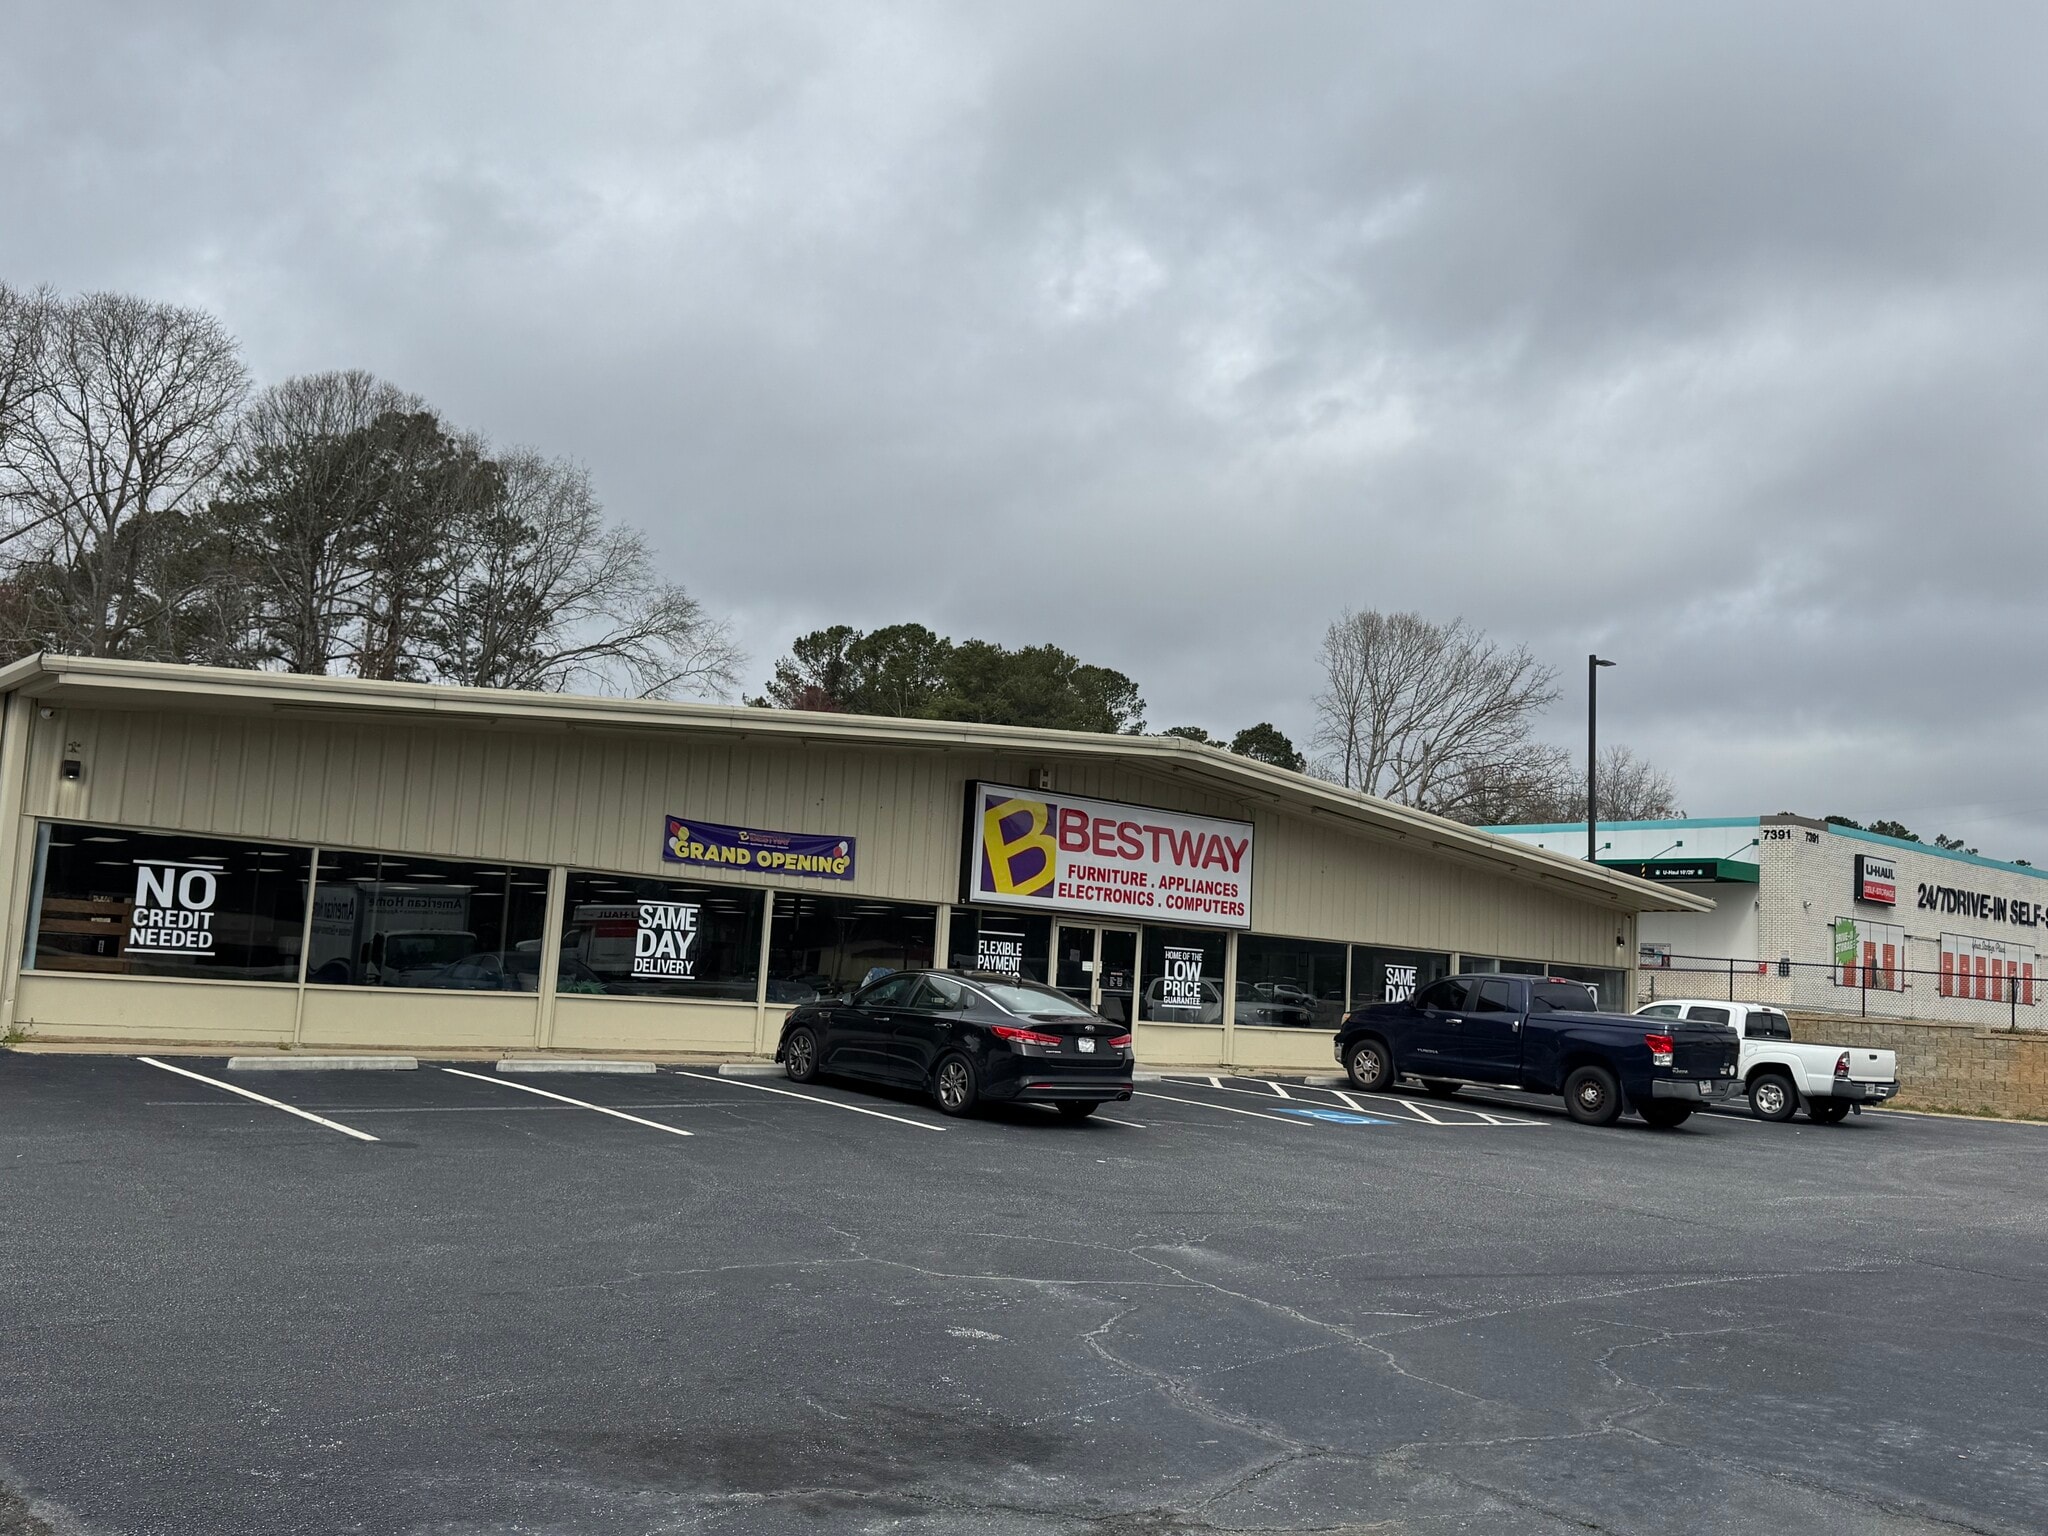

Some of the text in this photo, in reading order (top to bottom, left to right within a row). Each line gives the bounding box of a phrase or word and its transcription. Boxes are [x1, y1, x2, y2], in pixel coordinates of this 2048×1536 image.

[1059, 807, 1249, 874] BESTWAY
[1763, 829, 1791, 840] 7391
[1805, 831, 1820, 845] 7391
[674, 840, 846, 875] GRAND OPENING
[1068, 863, 1148, 888] FURNITURE
[1158, 875, 1239, 898] APPLIANCES
[1865, 863, 1896, 880] U-HAUL
[135, 866, 217, 910] NO
[1058, 882, 1154, 908] ELECTRONICS
[1166, 894, 1245, 917] COMPUTERS
[133, 907, 215, 930] CREDIT
[638, 904, 699, 931] SAME
[129, 927, 213, 949] NEEDED
[635, 928, 696, 960] DAY
[978, 939, 1023, 957] FLEXIBLE
[633, 957, 694, 975] DELIVERY
[977, 954, 1022, 972] PAYMENT
[1164, 950, 1203, 962] HOME OF THE
[1164, 959, 1203, 982] LOW
[1385, 967, 1417, 987] SAME
[1163, 980, 1201, 998] PRICE
[1163, 996, 1201, 1006] GUARANTEE
